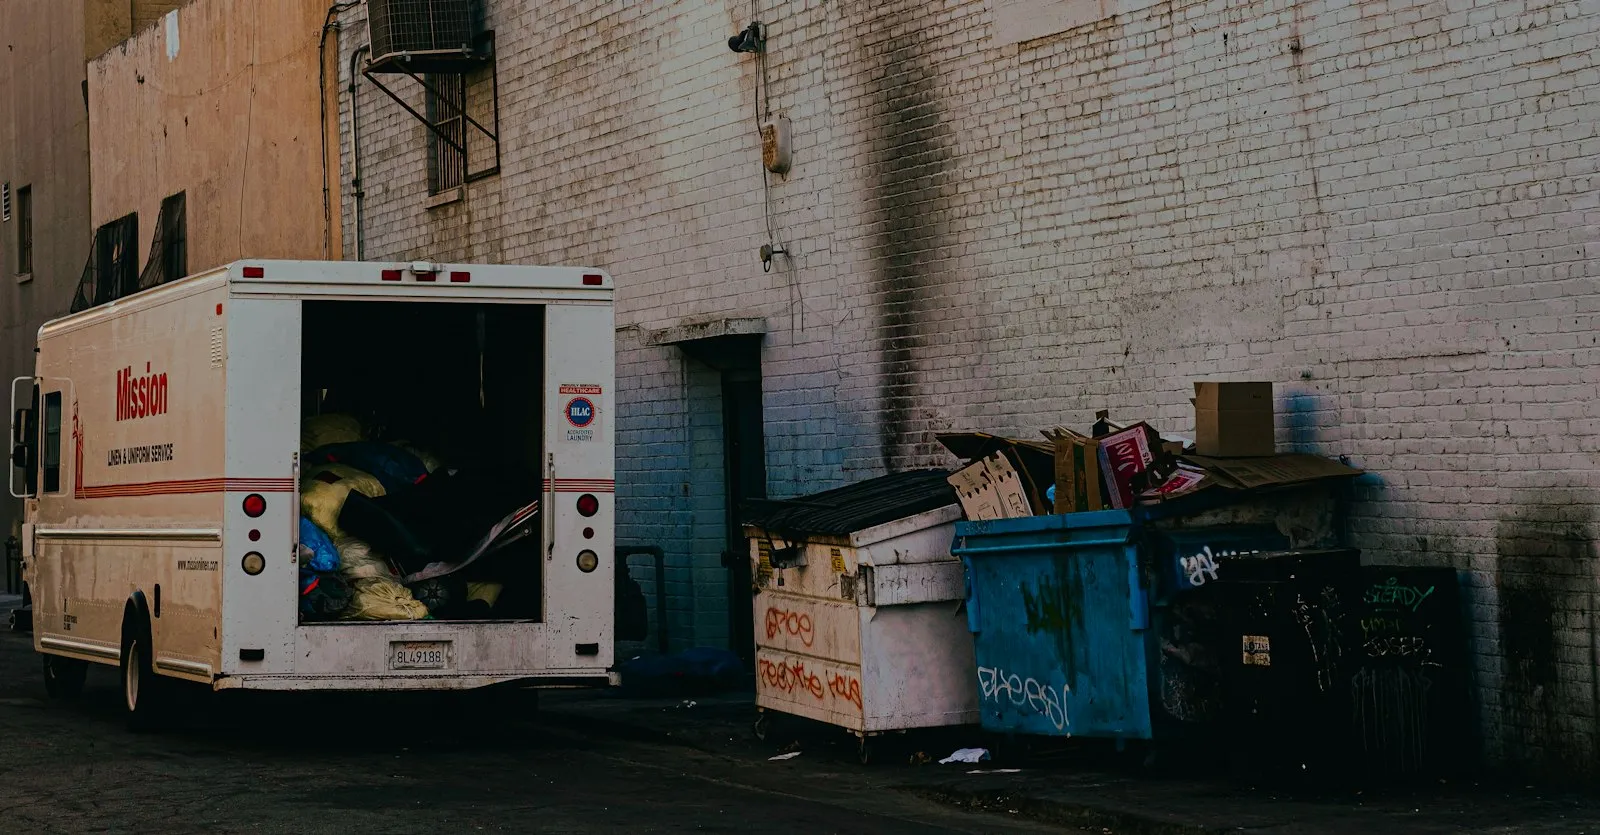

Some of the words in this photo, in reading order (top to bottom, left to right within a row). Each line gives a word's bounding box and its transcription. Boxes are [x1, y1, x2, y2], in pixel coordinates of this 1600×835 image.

[116, 361, 168, 422] Mission
[107, 449, 122, 467] LINEN
[128, 445, 151, 465] UNIFORM
[151, 443, 173, 462] SERVICE
[397, 650, 441, 663] 8L49188
